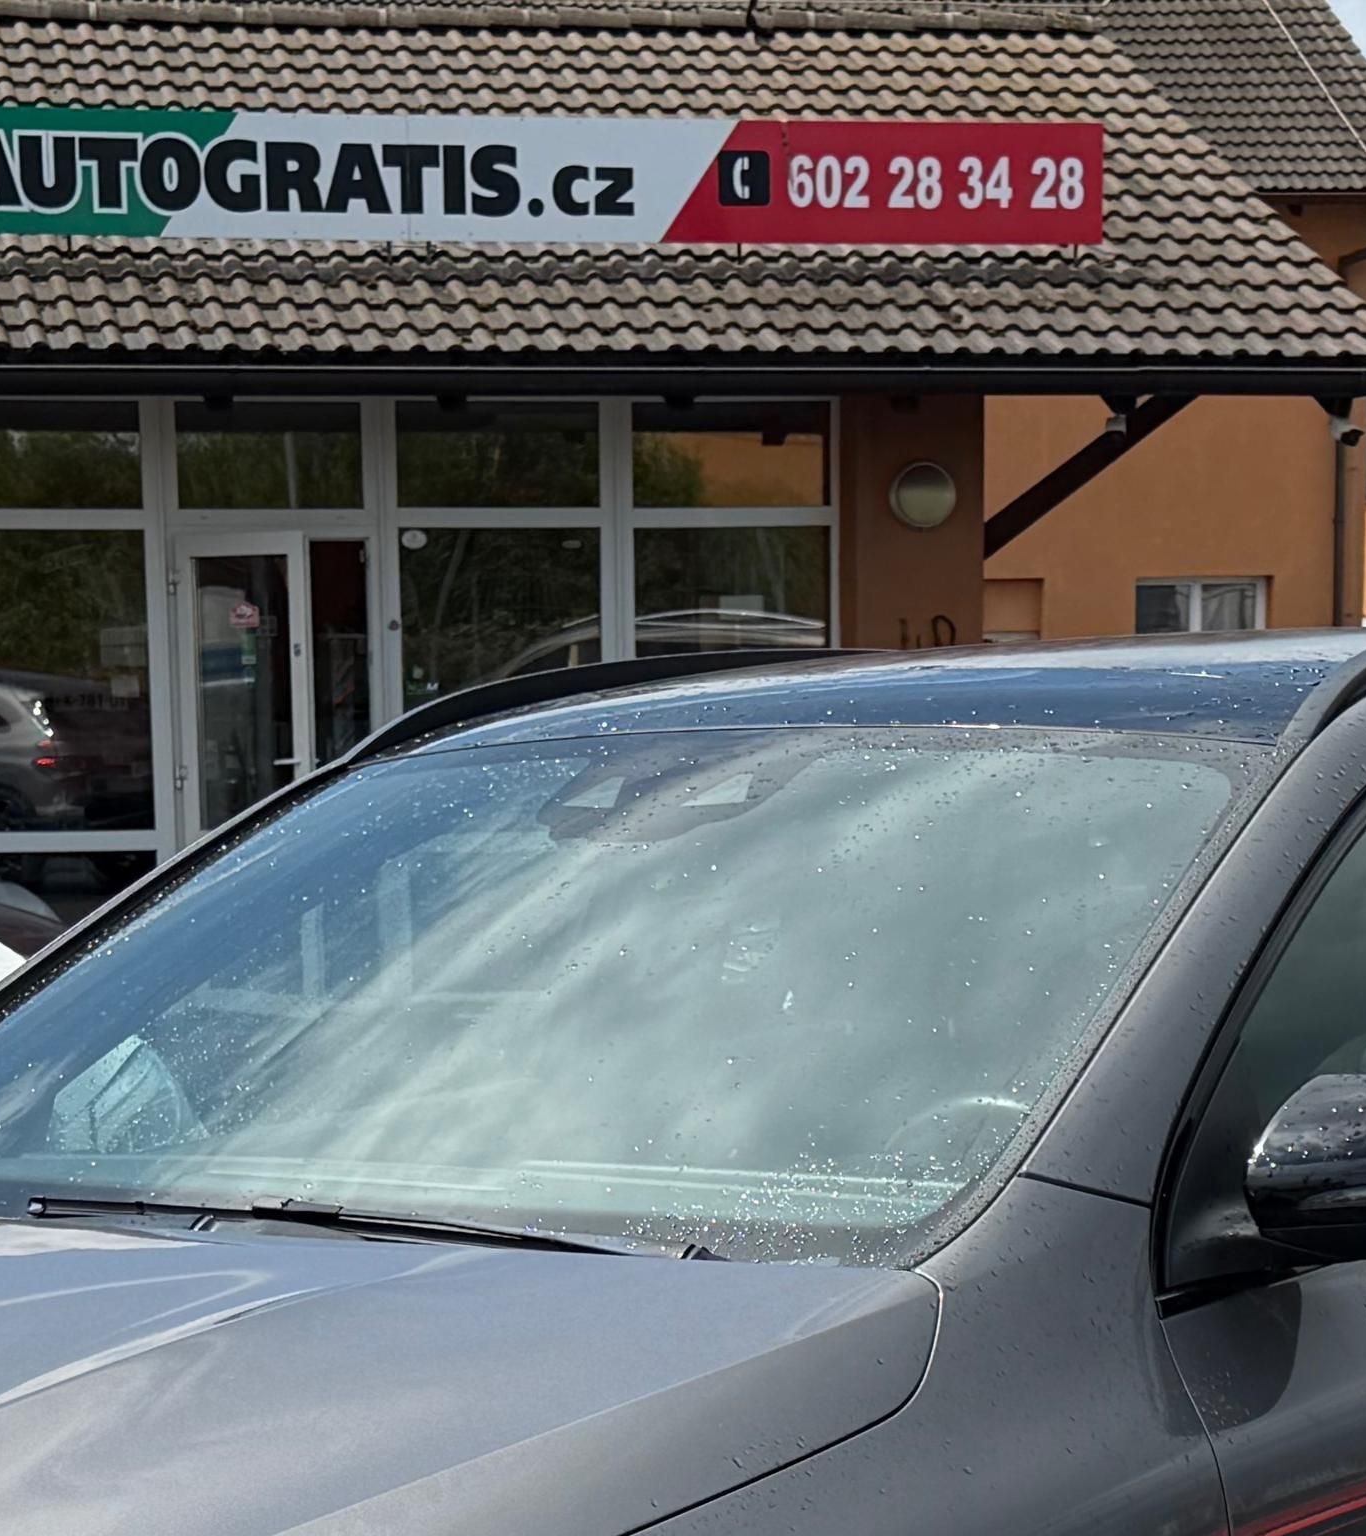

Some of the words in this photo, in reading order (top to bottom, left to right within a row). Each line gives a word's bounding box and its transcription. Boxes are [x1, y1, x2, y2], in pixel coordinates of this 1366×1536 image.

[787, 155, 869, 208] 602
[887, 156, 942, 208] 28
[958, 156, 1012, 209] 34
[1031, 156, 1084, 210] 28
